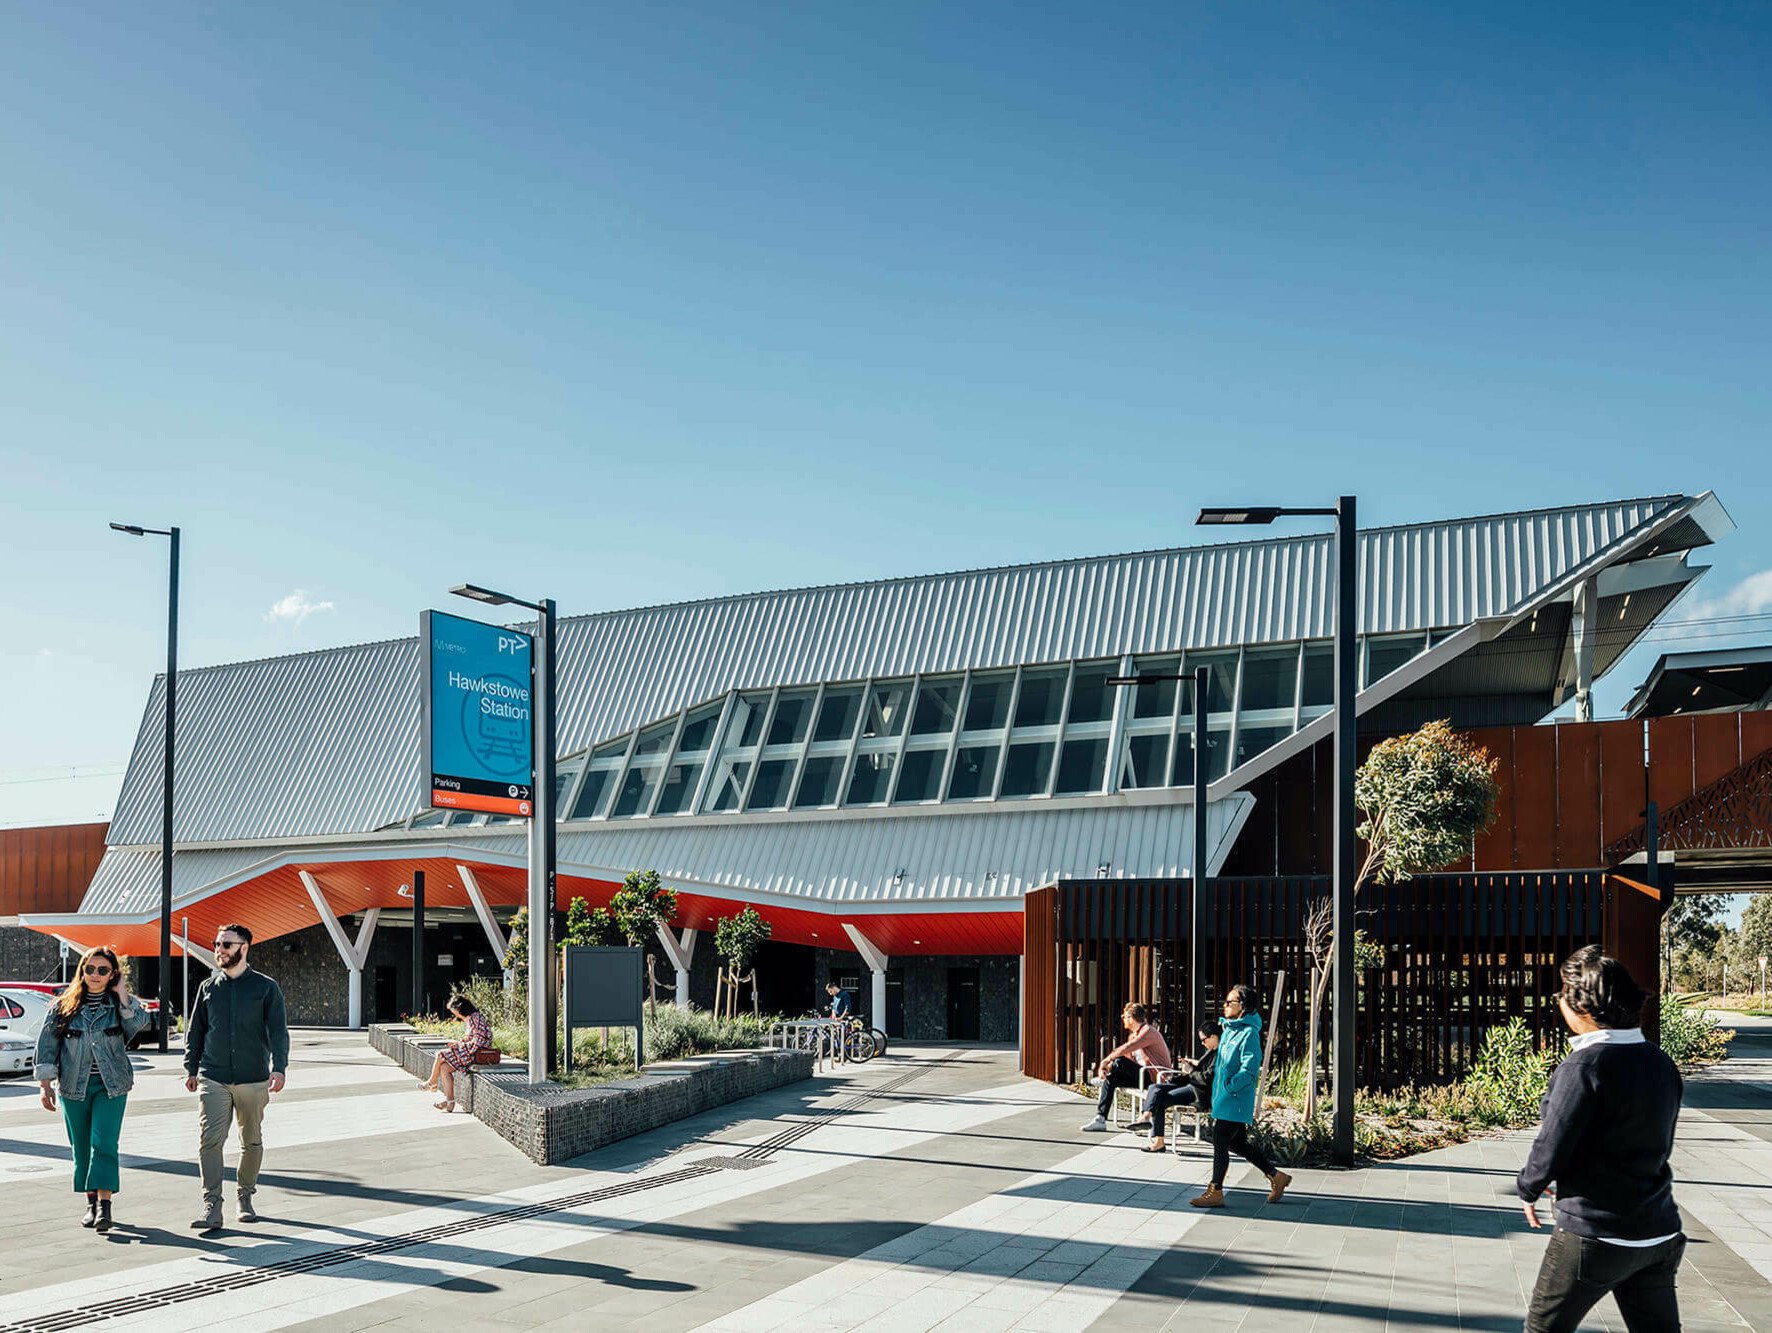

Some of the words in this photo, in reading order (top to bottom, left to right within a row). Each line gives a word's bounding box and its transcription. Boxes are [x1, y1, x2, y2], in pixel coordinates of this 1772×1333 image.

[449, 671, 529, 702] Hawkstowe
[481, 697, 529, 720] Station
[434, 778, 461, 791] Parking
[434, 794, 457, 805] Buses
